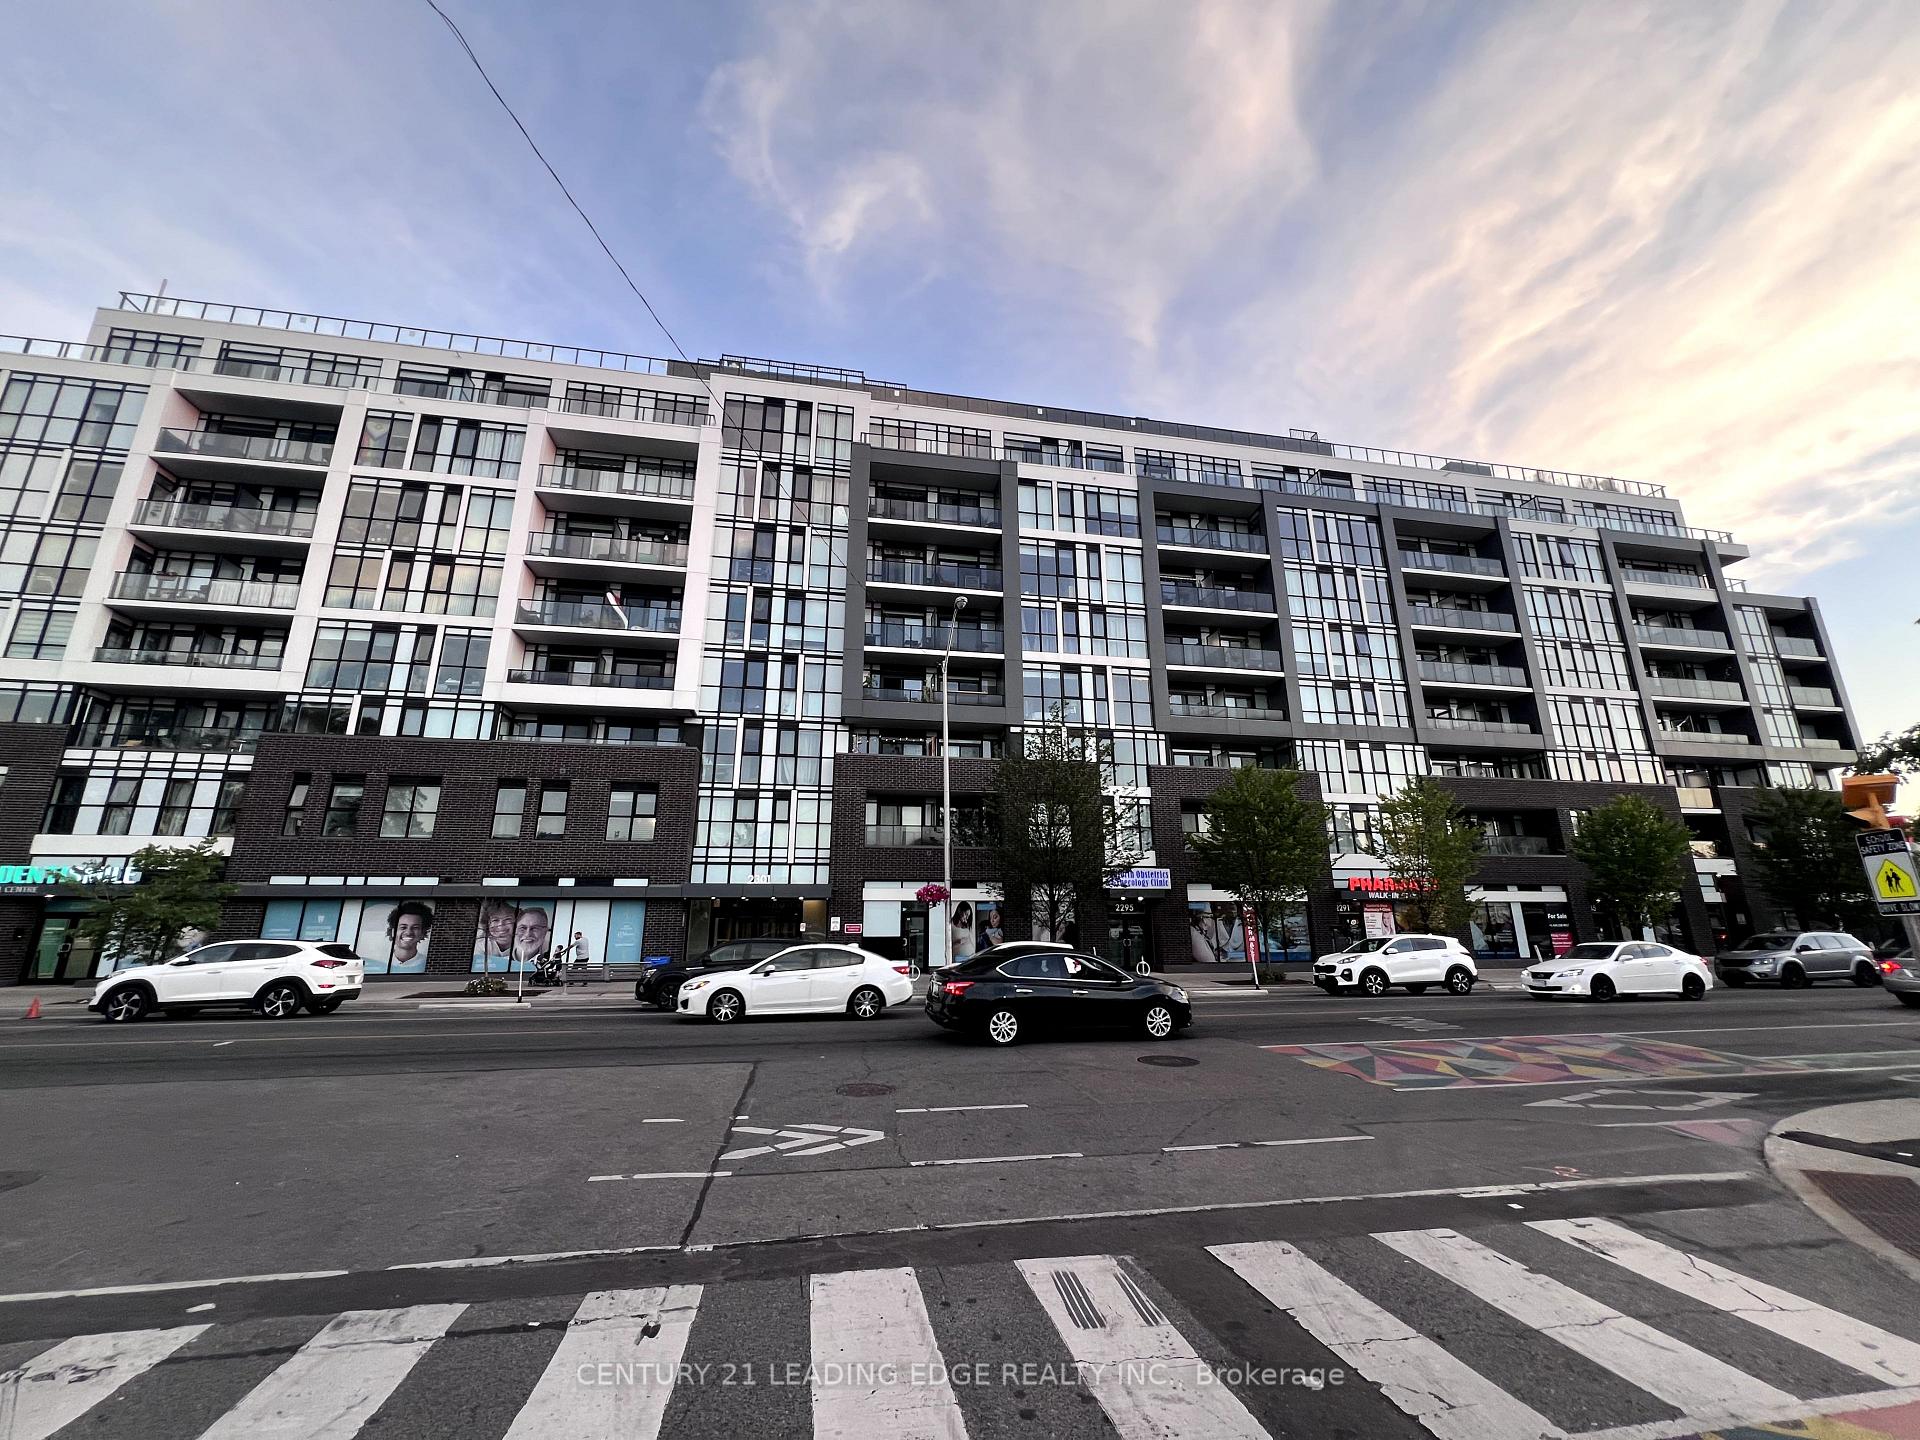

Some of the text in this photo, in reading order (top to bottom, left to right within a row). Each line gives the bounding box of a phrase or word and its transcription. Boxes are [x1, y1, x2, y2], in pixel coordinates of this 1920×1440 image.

[1866, 834, 1894, 844] SCHOOL
[1861, 842, 1906, 854] SAFETY ZONE
[1136, 870, 1169, 878] Obstetrics
[747, 874, 771, 884] 2301
[1150, 878, 1169, 887] Clinic
[1115, 904, 1134, 912] 2295
